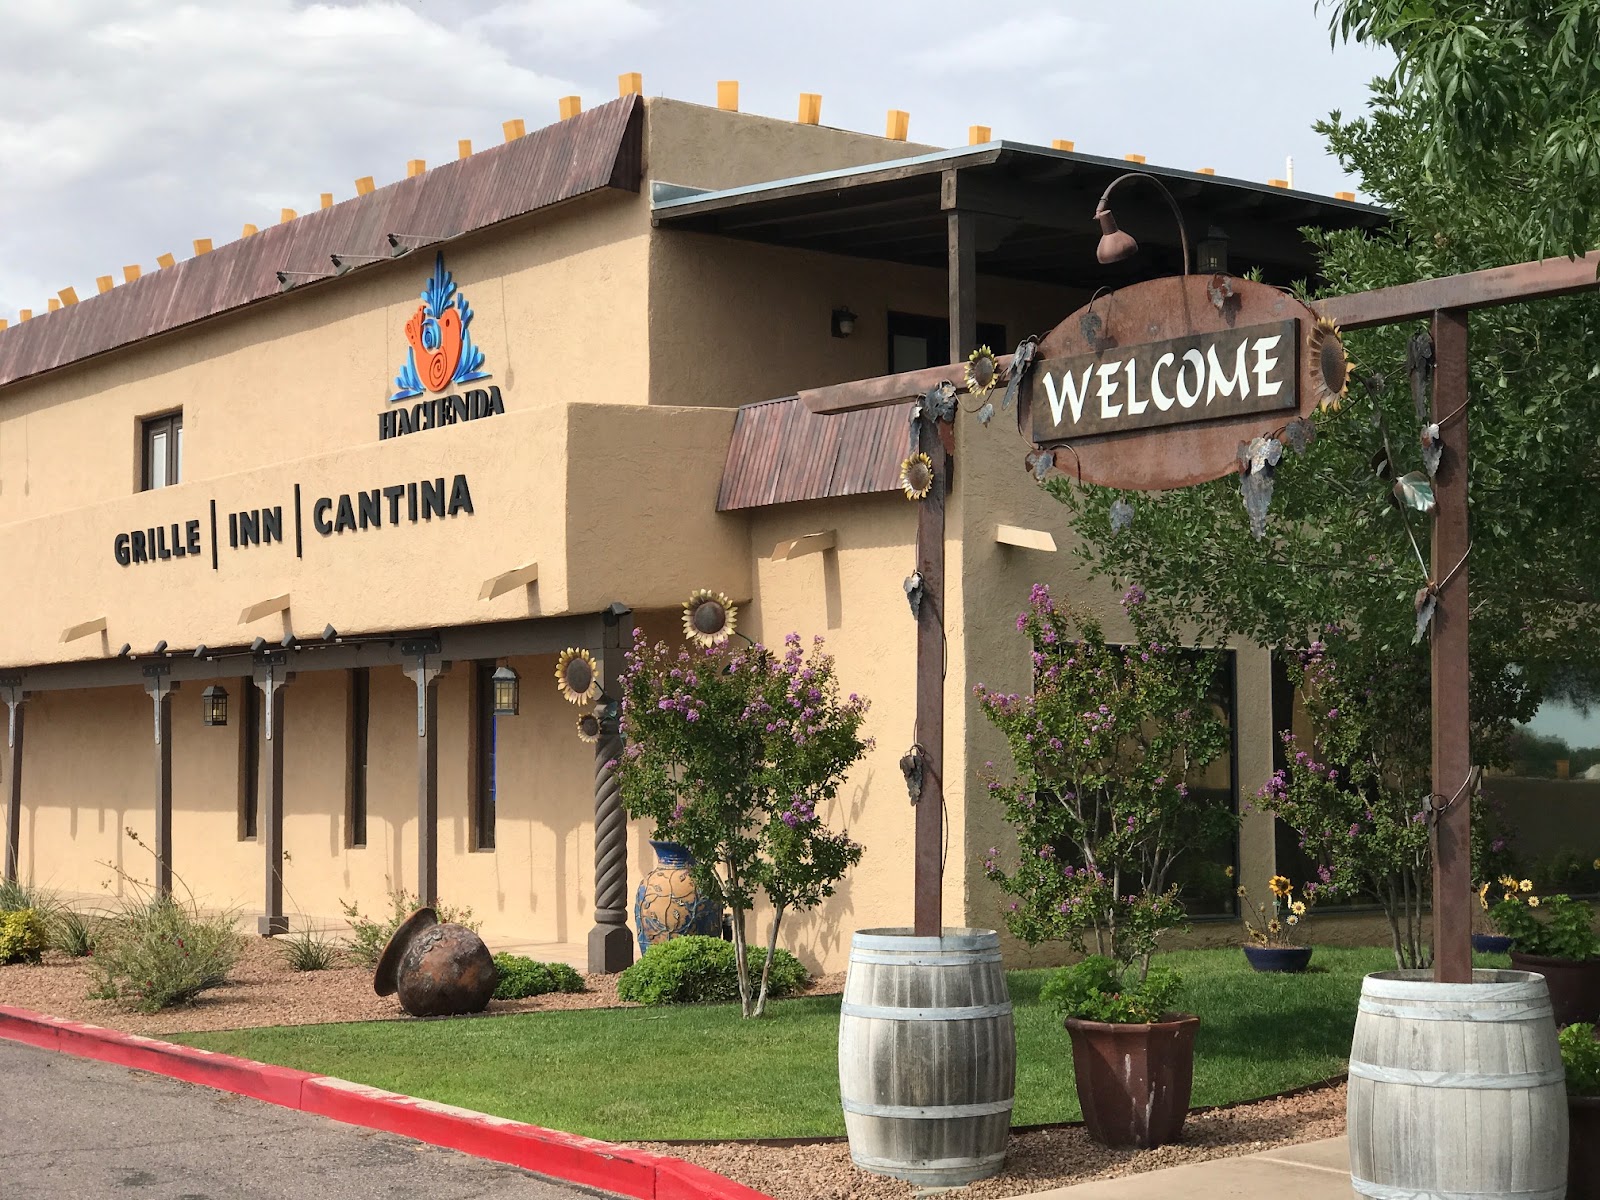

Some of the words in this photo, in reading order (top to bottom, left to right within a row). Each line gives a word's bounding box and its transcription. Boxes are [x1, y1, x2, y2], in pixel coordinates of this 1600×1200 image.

[378, 385, 505, 440] HACIENDA
[1042, 334, 1283, 427] WELCOME
[114, 519, 201, 566] GRILLE
[228, 506, 282, 548] INN
[313, 474, 474, 535] CANTINA
